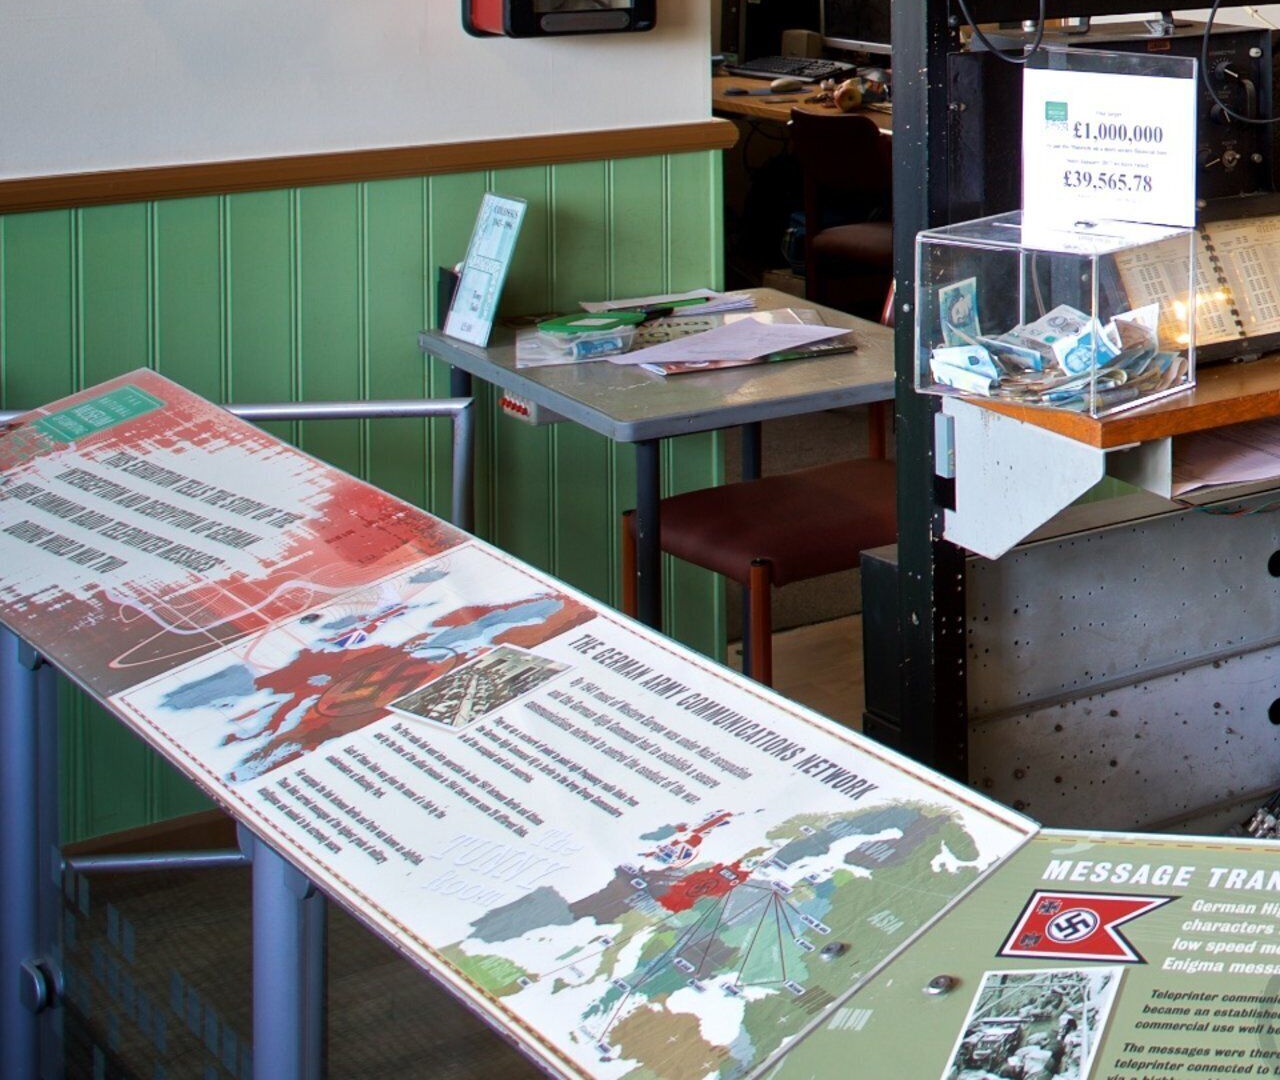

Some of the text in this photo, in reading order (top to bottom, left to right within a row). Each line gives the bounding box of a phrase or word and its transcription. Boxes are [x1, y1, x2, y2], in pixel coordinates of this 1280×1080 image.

[1073, 121, 1163, 144] £1,000,000
[568, 634, 879, 801] THE GERMAN ARMY COMMUNICATIONS NETWORK
[1042, 860, 1196, 887] MESSAGE
[1192, 900, 1256, 914] German
[1182, 919, 1274, 935] characters
[1172, 938, 1202, 951] low
[1205, 941, 1256, 956] speed
[1162, 957, 1222, 973] Enigma
[1152, 989, 1219, 1002] Teleprinter
